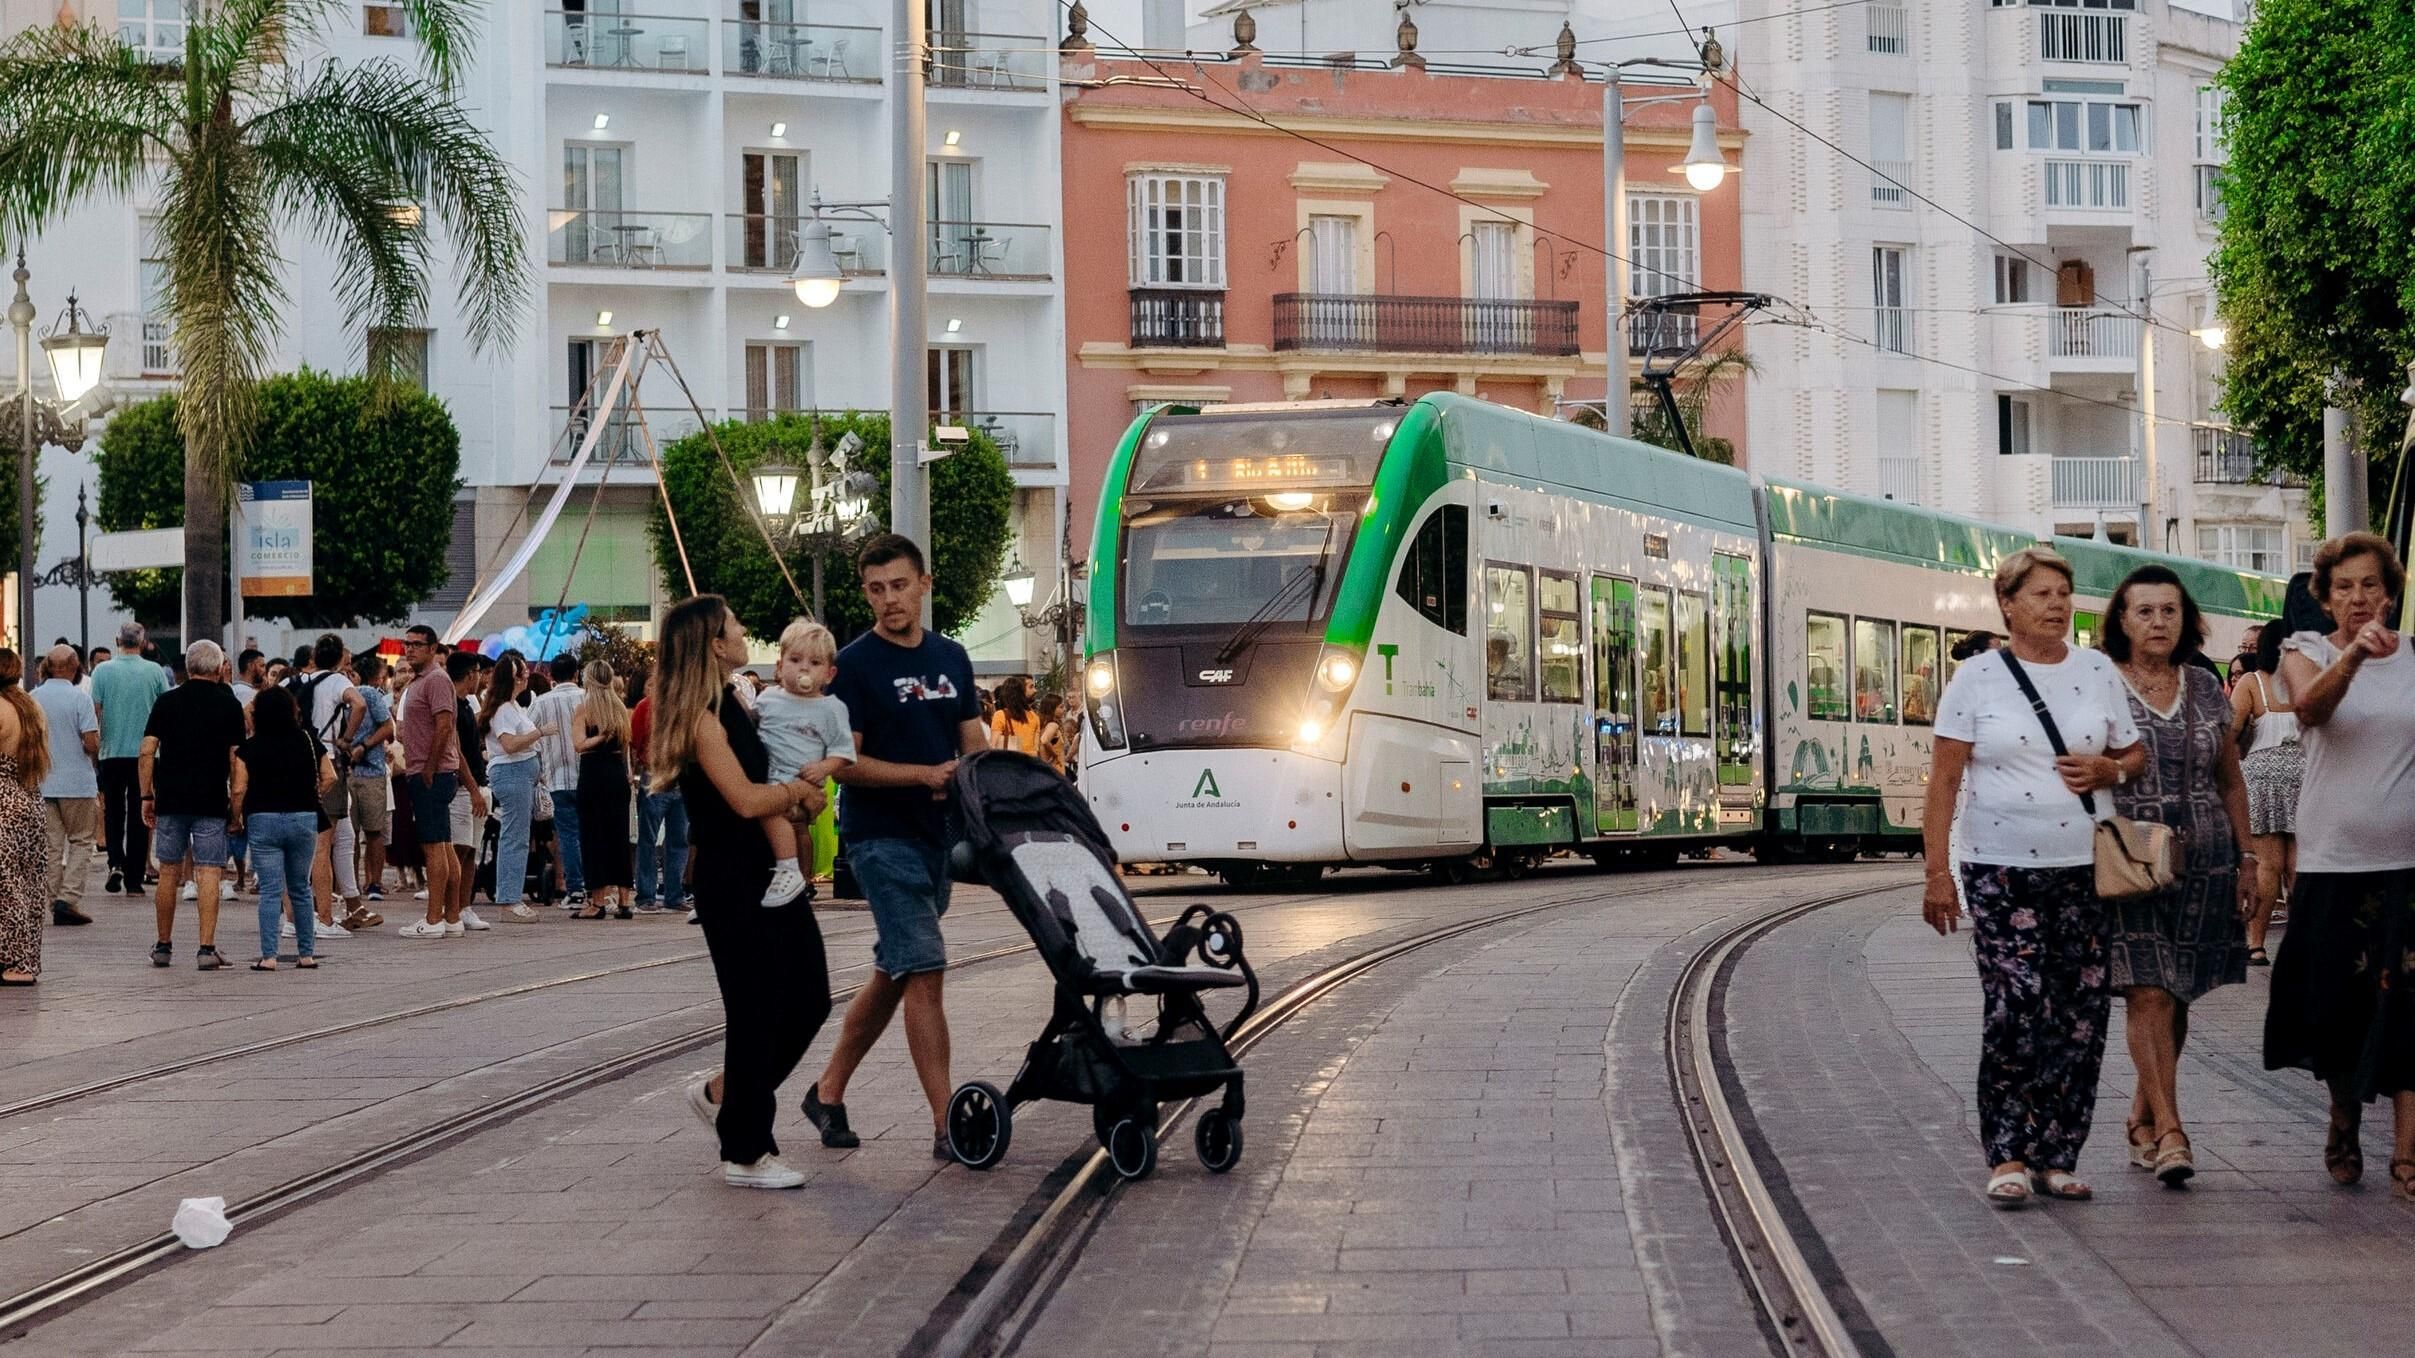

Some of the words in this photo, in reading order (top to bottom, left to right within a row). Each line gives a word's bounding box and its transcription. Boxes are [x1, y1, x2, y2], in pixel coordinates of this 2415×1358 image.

[259, 526, 291, 549] isla
[250, 552, 299, 560] COMERCIO
[893, 673, 957, 703] FILA
[1178, 711, 1248, 737] renfe
[1175, 801, 1195, 809] Junta
[1206, 800, 1241, 808] Andalucía
